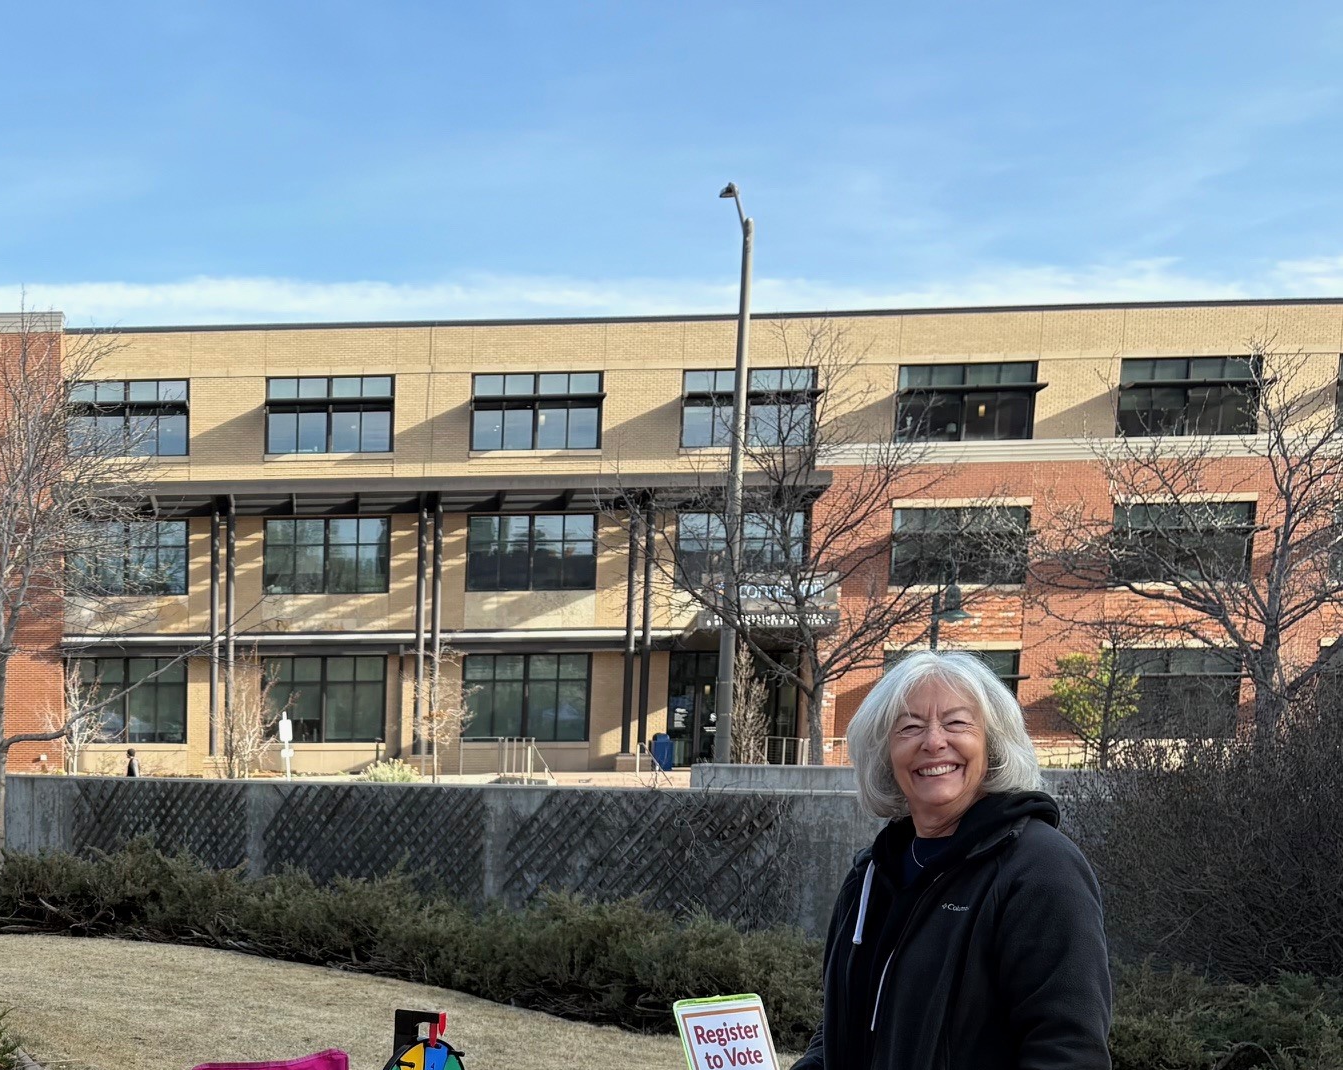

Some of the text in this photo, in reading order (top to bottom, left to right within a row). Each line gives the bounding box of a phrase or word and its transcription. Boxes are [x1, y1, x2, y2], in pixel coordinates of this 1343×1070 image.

[694, 1022, 758, 1046] Register
[705, 1048, 763, 1069] to Vote
